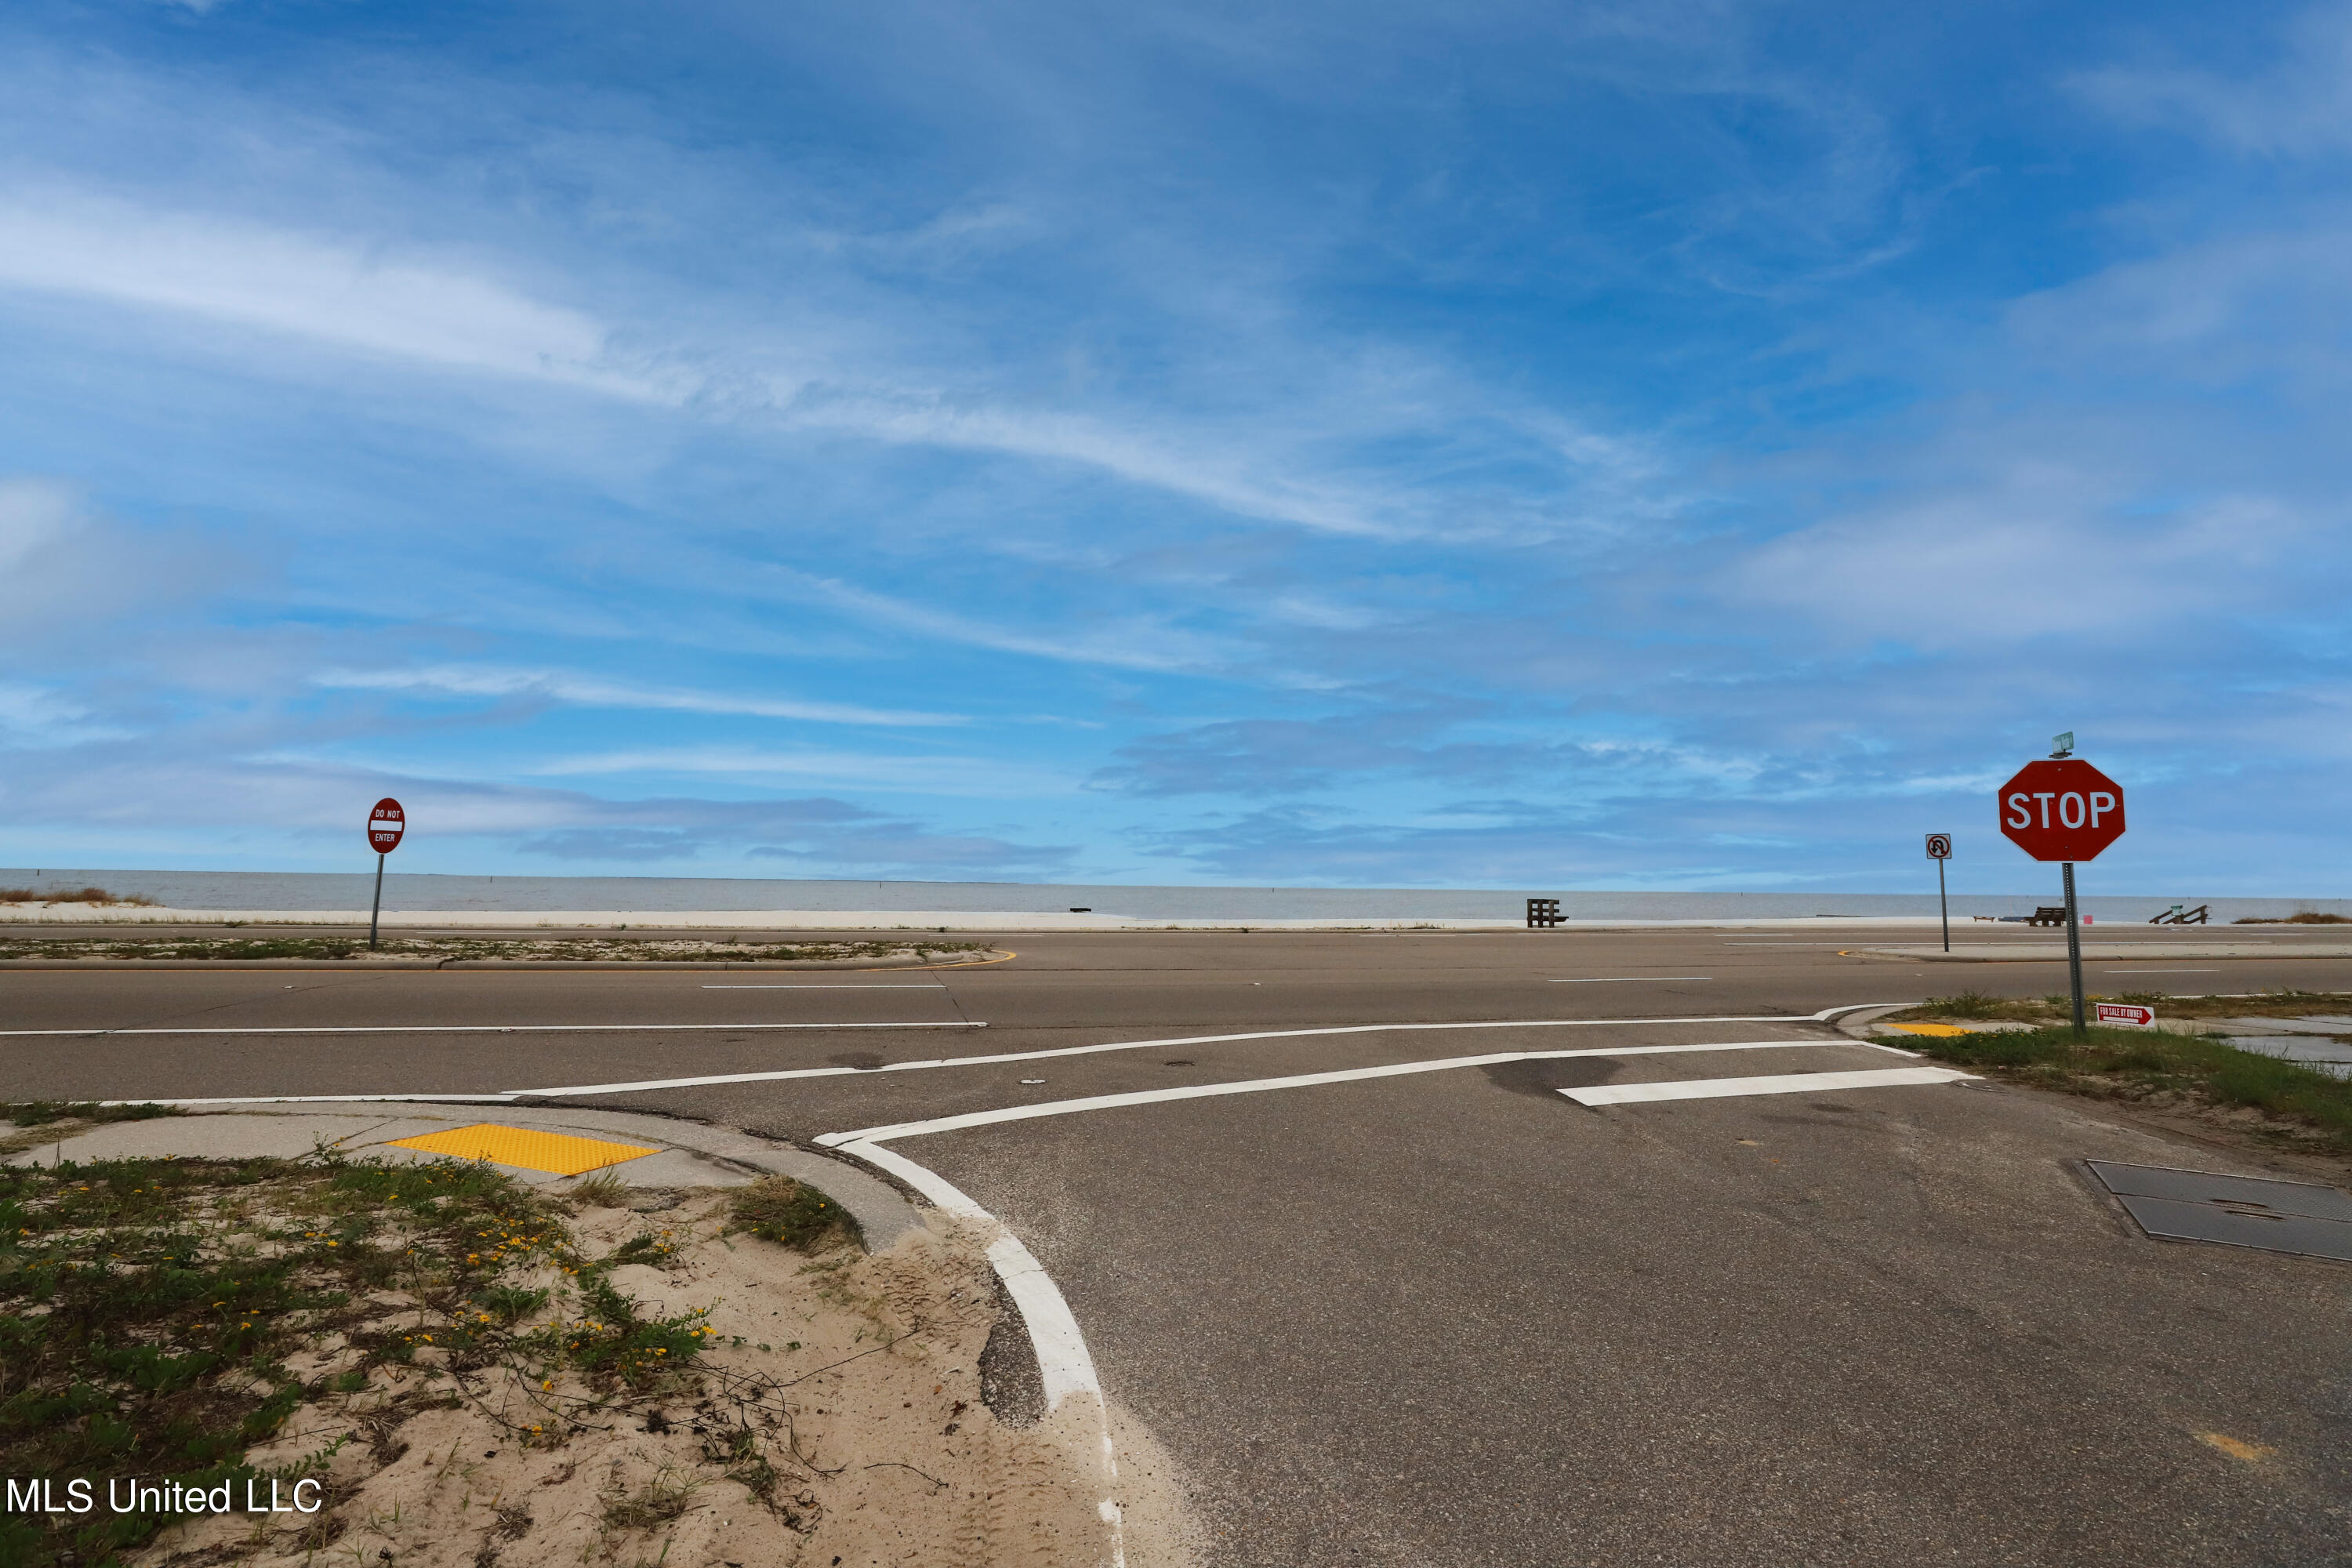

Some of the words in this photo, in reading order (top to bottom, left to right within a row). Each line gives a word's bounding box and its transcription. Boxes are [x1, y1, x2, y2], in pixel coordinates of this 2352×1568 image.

[376, 809, 384, 818] DO
[387, 810, 400, 818] NOT
[2007, 791, 2116, 829] STOP
[375, 833, 395, 842] ENTER
[2100, 1007, 2108, 1015] FOR
[2109, 1007, 2120, 1016] SALE
[2121, 1008, 2126, 1017] BY
[2127, 1009, 2143, 1018] OWNER
